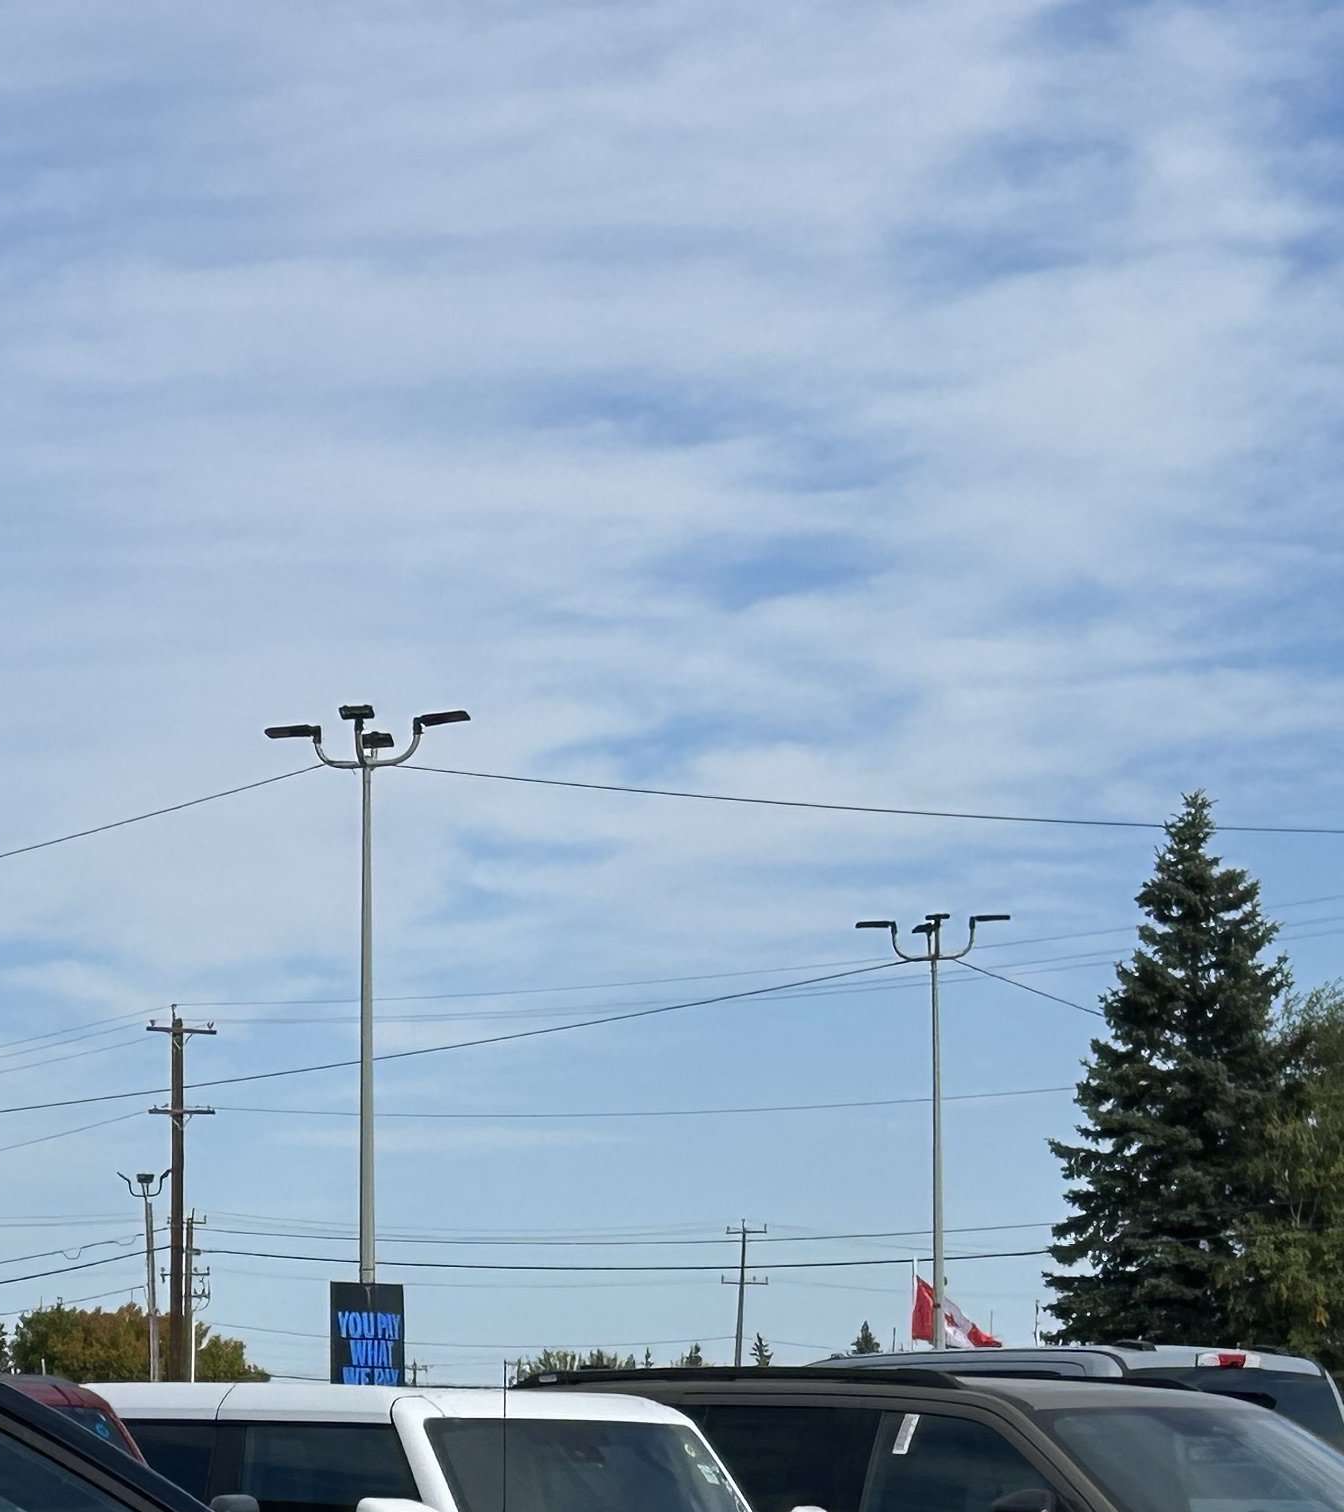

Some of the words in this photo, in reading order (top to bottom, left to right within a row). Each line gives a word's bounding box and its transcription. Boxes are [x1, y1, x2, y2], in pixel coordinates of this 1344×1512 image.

[337, 1310, 375, 1339] YOU
[376, 1312, 402, 1340] PAY
[349, 1339, 395, 1368] WHAT
